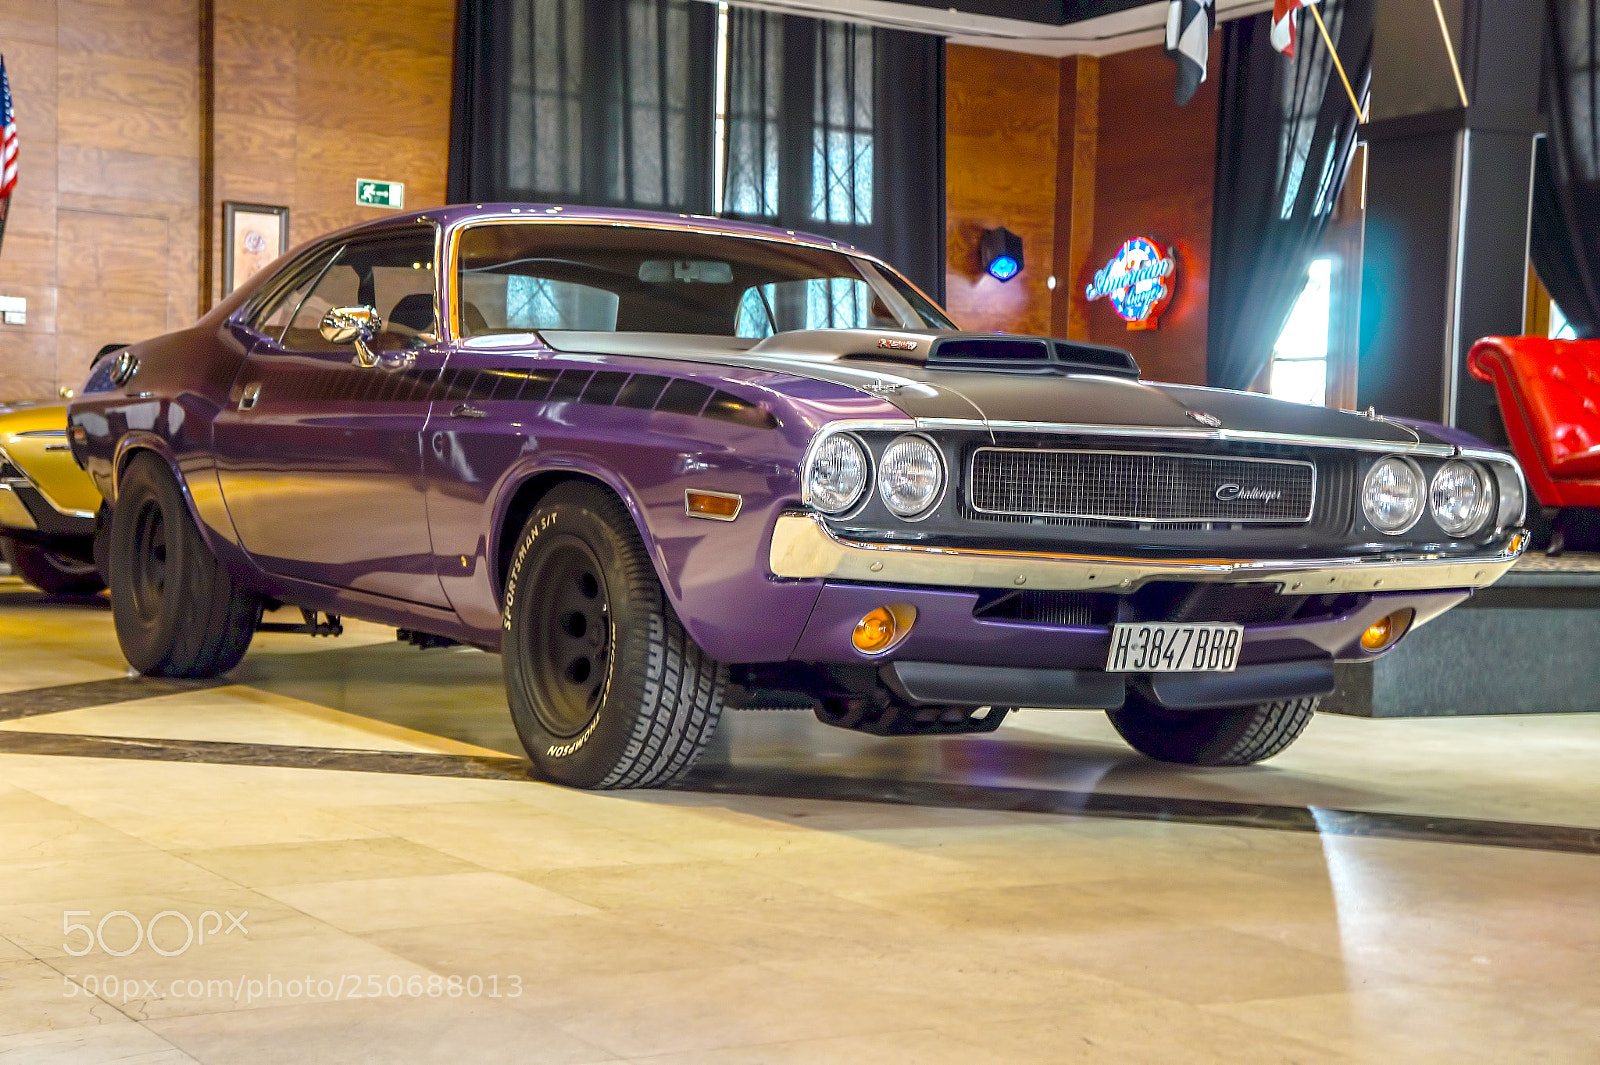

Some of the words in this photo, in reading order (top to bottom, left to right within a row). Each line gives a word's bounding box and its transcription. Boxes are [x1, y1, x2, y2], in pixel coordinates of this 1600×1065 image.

[1216, 483, 1281, 504] Challenger
[503, 524, 540, 631] SPORTSMAN
[541, 512, 558, 530] S/T
[546, 711, 601, 758] THOMPSON
